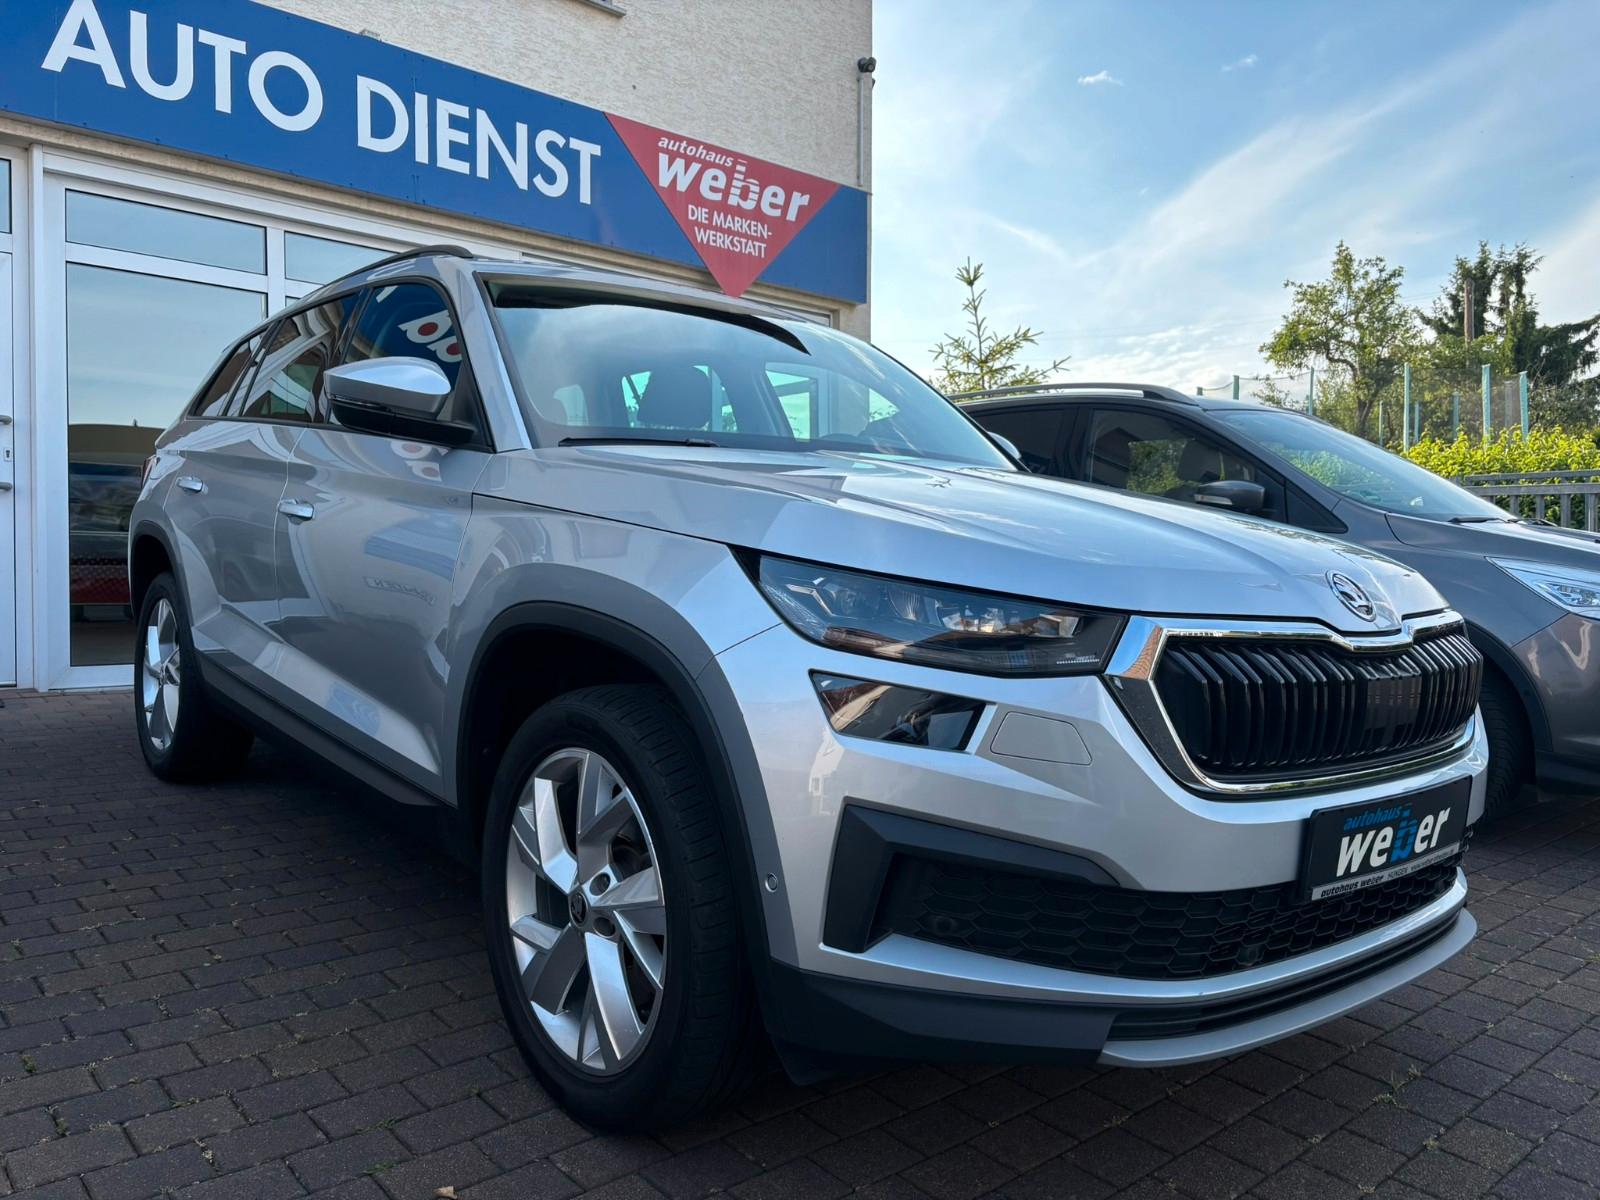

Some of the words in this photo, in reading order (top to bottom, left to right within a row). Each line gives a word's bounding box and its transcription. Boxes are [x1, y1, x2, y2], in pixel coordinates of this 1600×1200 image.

[41, 0, 323, 132] AUTO
[356, 75, 601, 205] DIENST
[658, 136, 734, 167] autohaus
[658, 152, 809, 221] weber
[688, 204, 709, 224] DIE
[712, 212, 772, 238] MARKEN-
[694, 227, 766, 258] WERKSTATT
[1343, 806, 1402, 831] autohaus
[1336, 803, 1451, 877] weber
[1320, 881, 1359, 897] autohaus
